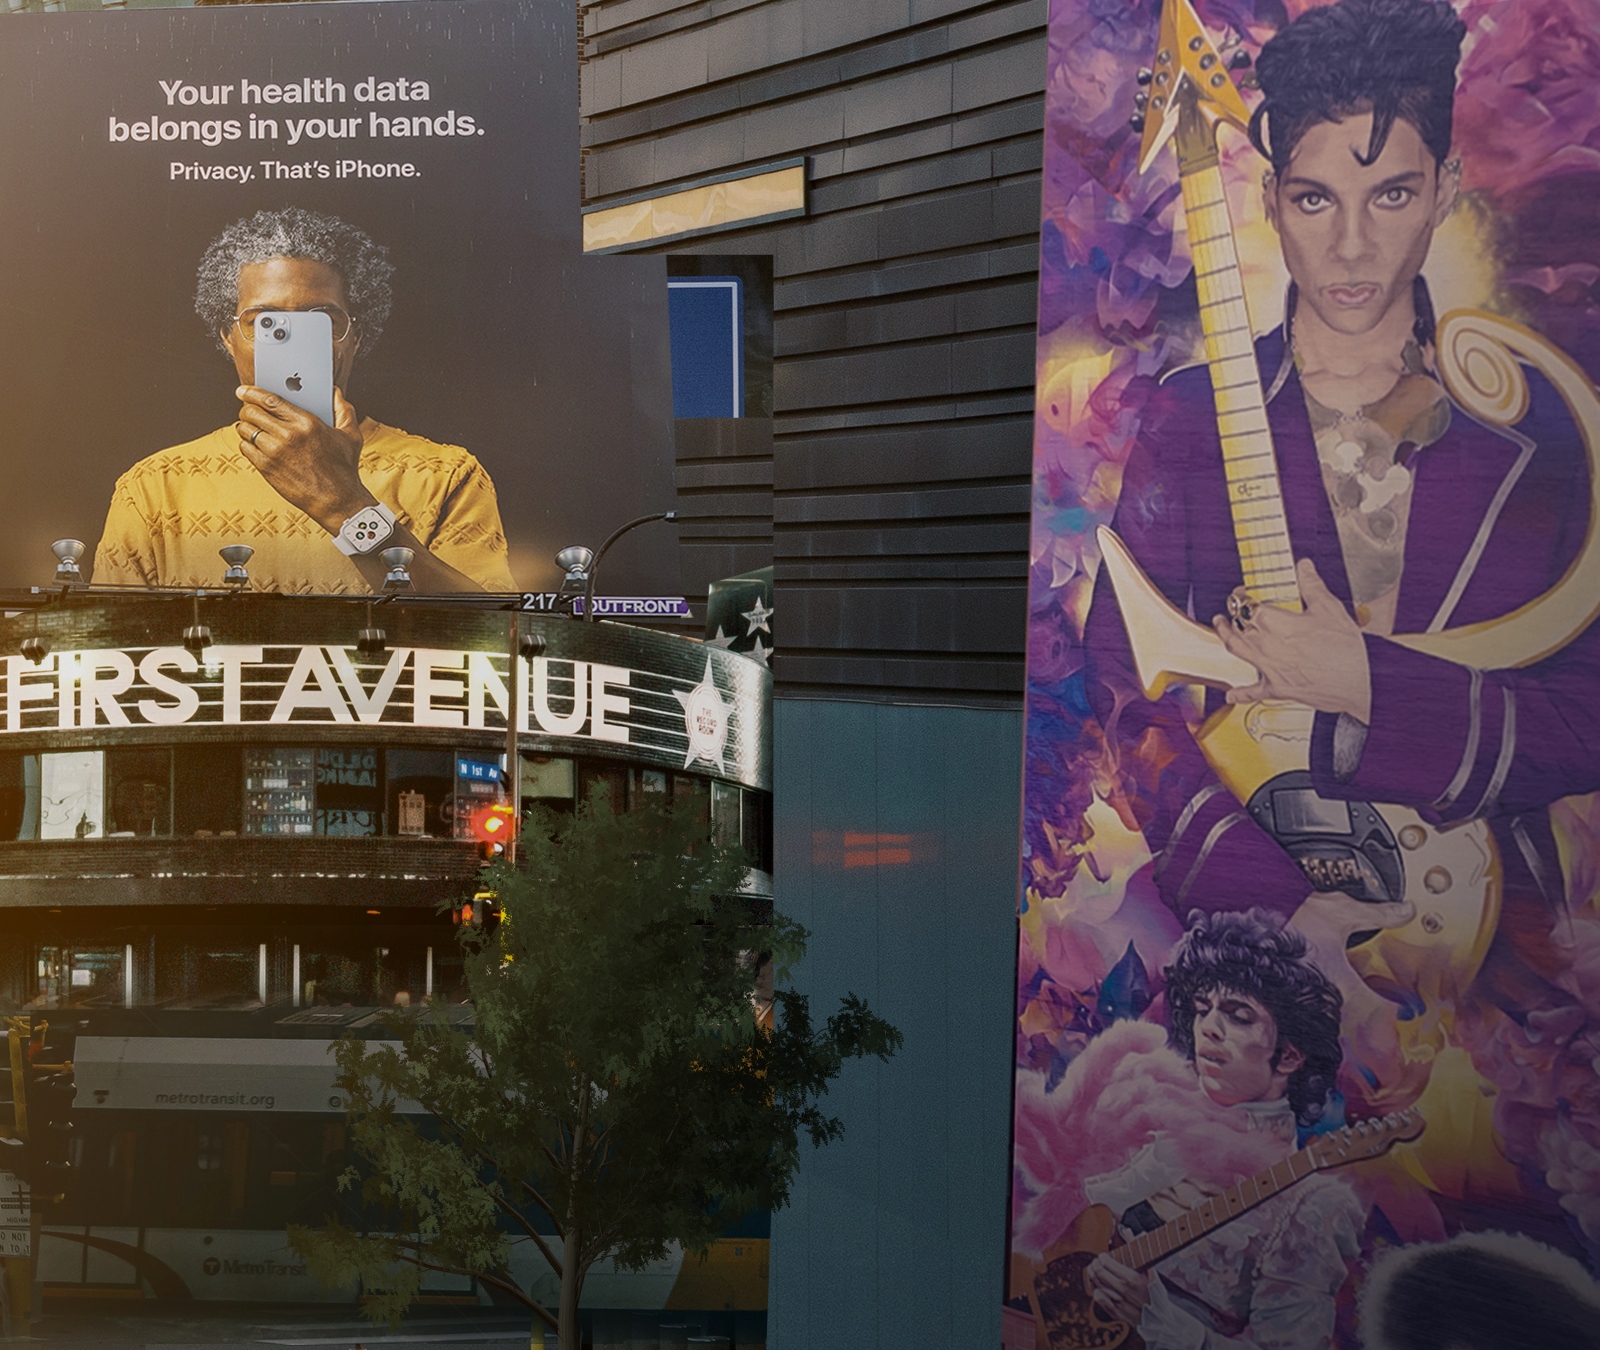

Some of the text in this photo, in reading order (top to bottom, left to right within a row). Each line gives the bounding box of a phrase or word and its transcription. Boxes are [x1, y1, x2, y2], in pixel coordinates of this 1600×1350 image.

[159, 76, 430, 108] Your health data
[108, 109, 486, 147] belongs in your hands.
[170, 158, 422, 185] Privacy. That’s iPhone.
[522, 593, 557, 610] 217
[591, 600, 683, 614] OUTFRONT
[8, 645, 631, 742] FIRST AVENUE
[701, 707, 712, 717] THE
[460, 763, 498, 779] N 1st Av
[155, 1091, 275, 1110] metrotransit.org
[11, 1232, 26, 1241] NOT
[10, 1244, 20, 1253] TO
